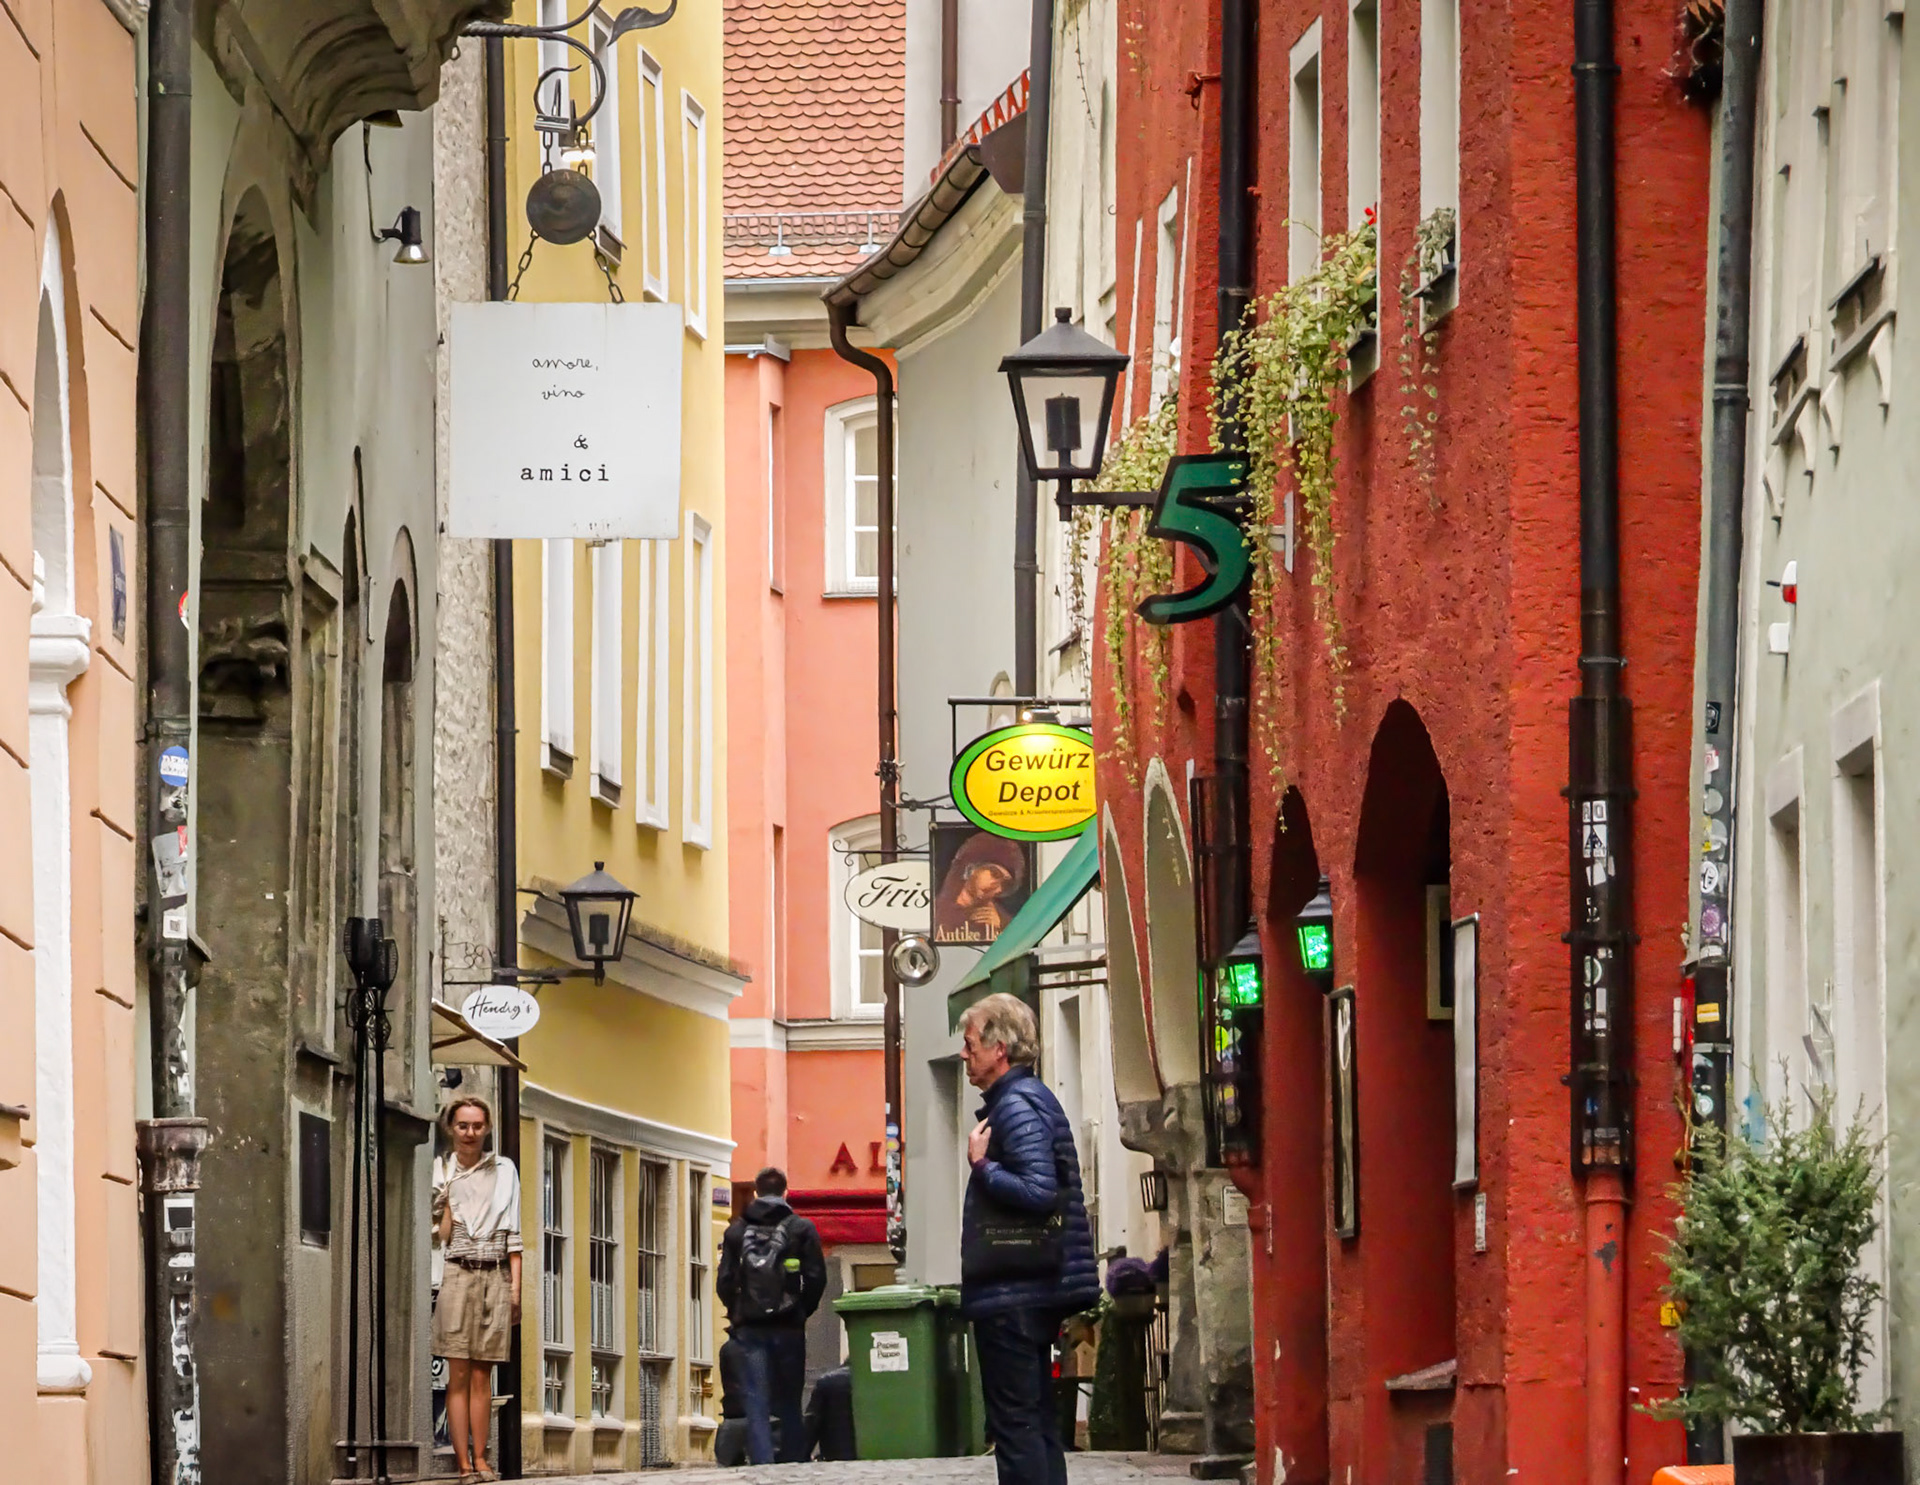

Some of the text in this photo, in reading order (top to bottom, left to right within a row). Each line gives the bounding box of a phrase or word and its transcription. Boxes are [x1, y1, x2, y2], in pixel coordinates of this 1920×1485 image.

[532, 358, 599, 371] amore,
[541, 384, 585, 400] vino
[573, 434, 589, 450] &
[520, 463, 610, 482] amici
[1134, 453, 1251, 625] 5
[985, 748, 1091, 772] Gewürz
[998, 780, 1081, 807] Depot
[935, 920, 981, 942] Antike
